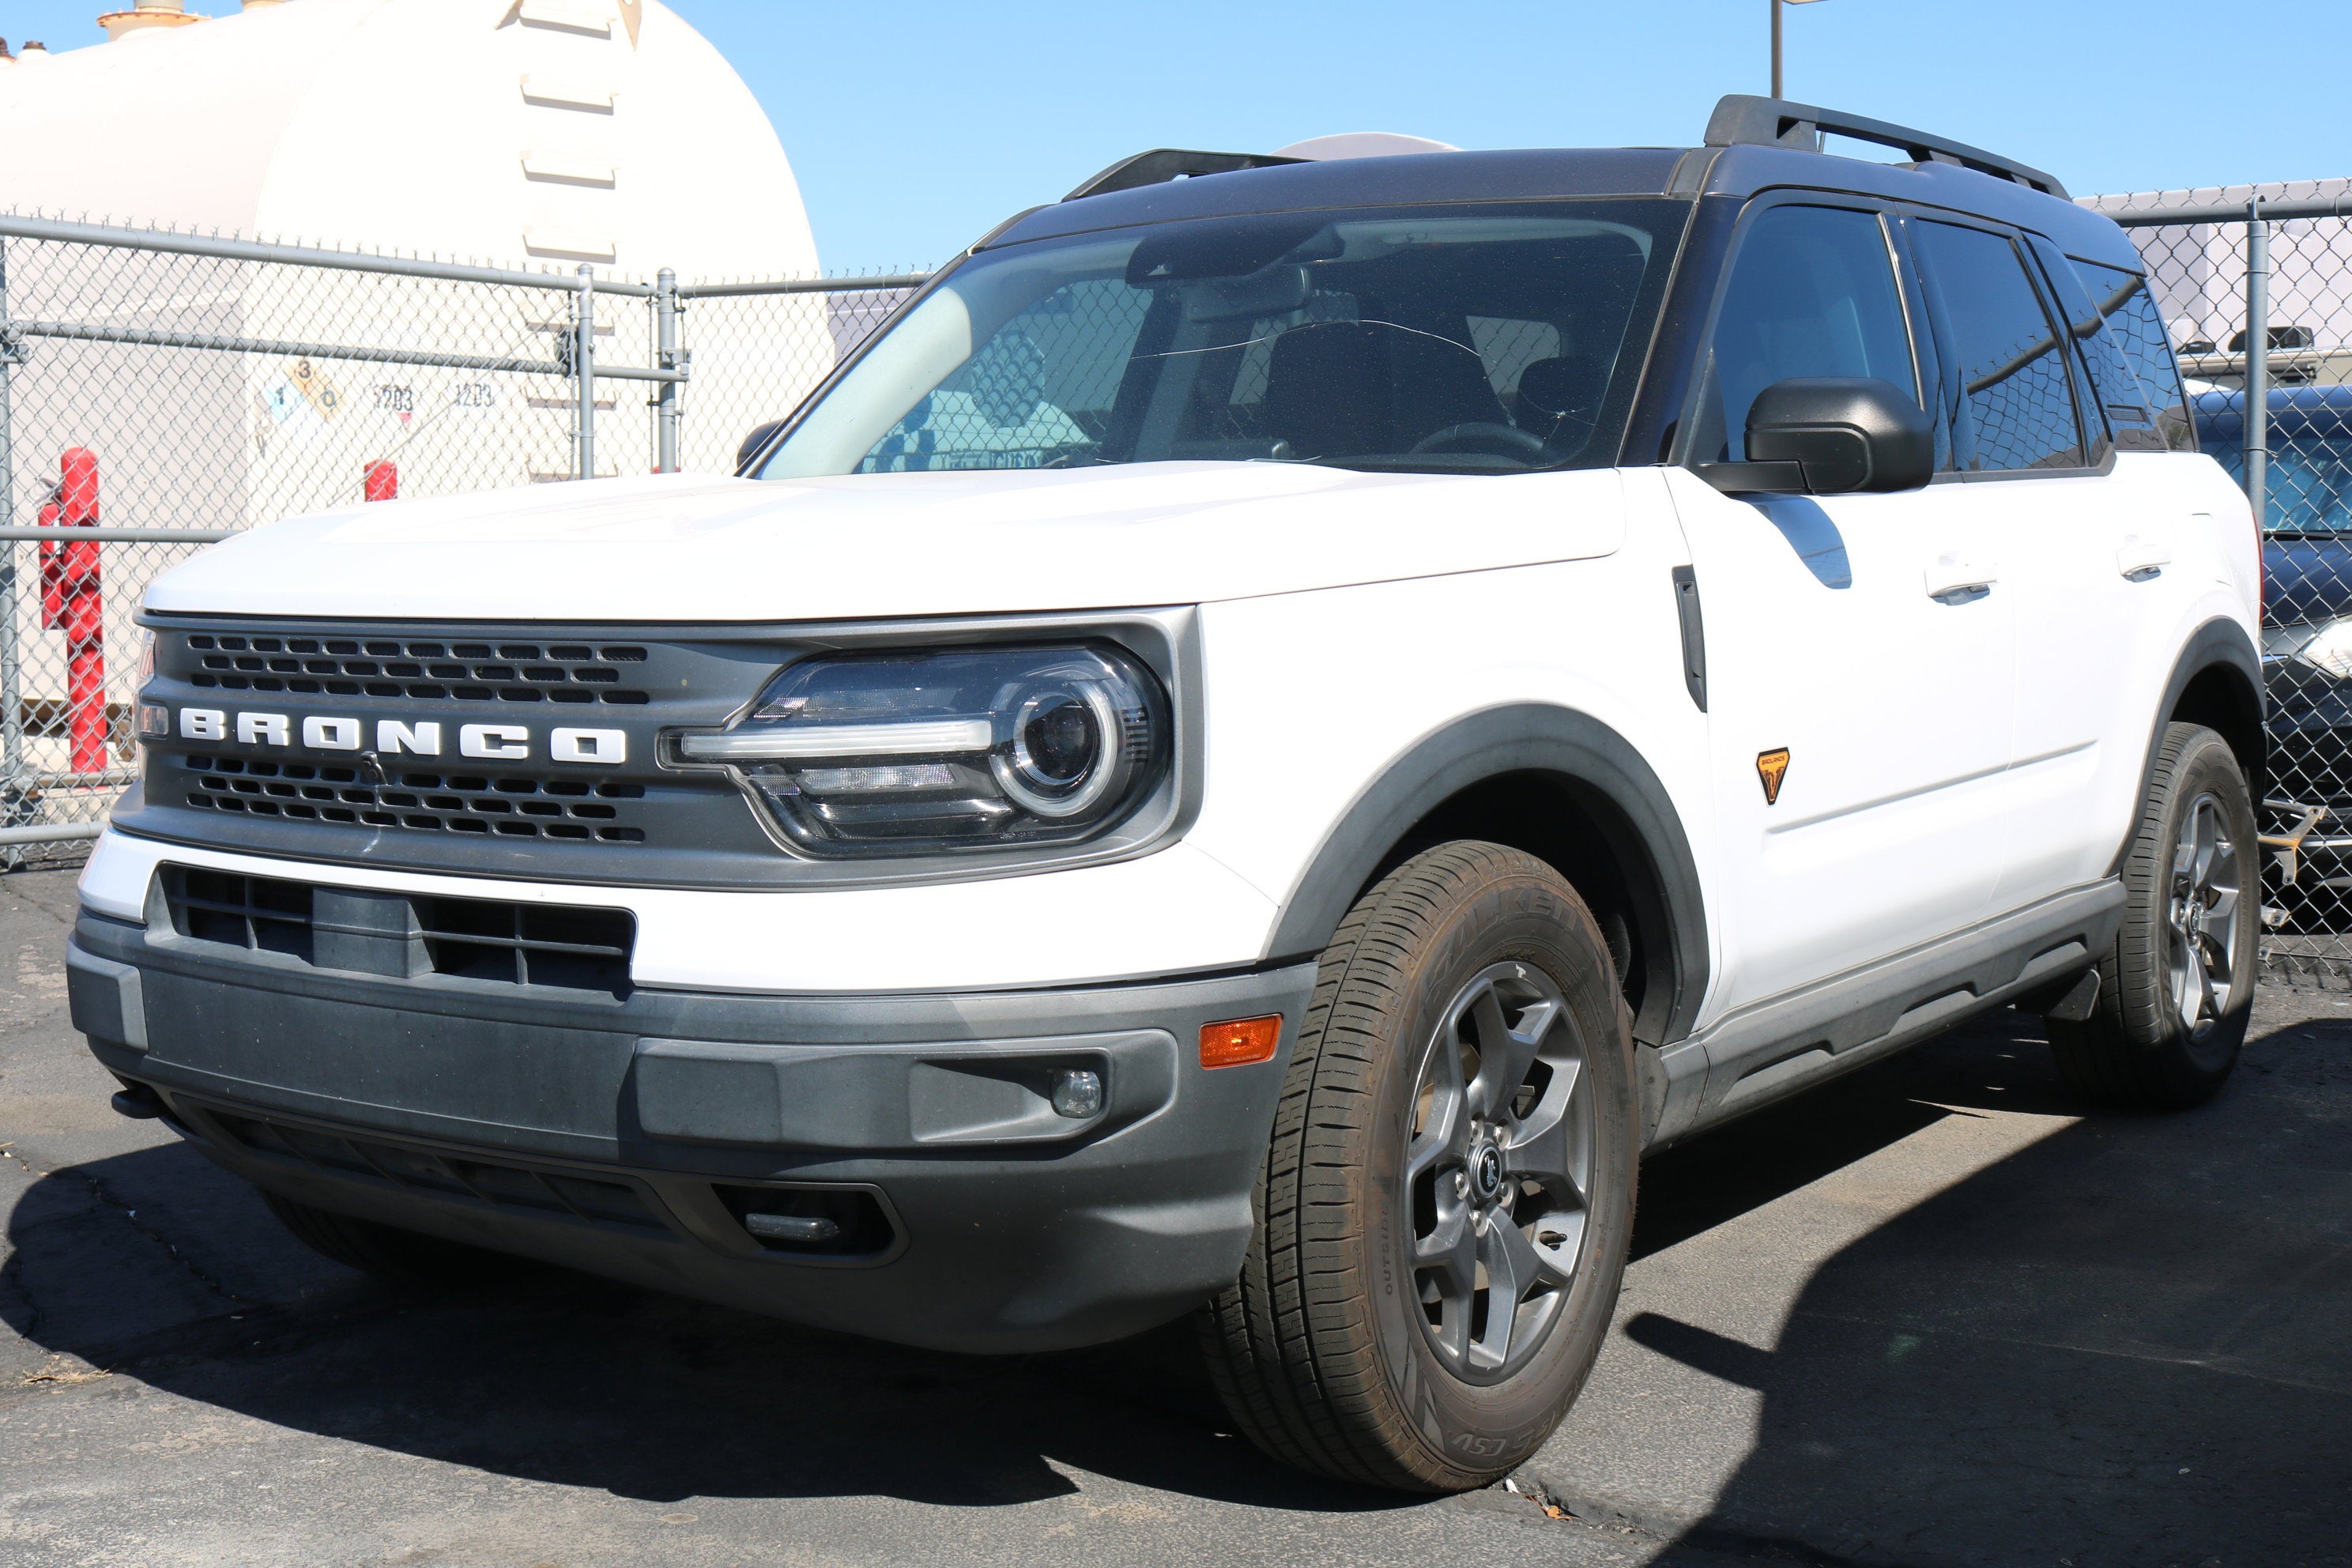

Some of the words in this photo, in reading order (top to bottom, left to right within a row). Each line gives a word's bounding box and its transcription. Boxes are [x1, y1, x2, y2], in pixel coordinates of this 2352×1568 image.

[299, 360, 311, 379] 3
[276, 387, 284, 405] 1
[322, 390, 336, 407] 0
[456, 384, 493, 407] 1203
[180, 707, 626, 763] BRONCO
[1762, 756, 1785, 765] BADLANDS
[1424, 888, 1579, 1004] FALKEN
[1381, 1203, 1393, 1295] OUTSIDE
[1451, 1432, 1507, 1457] CSV
